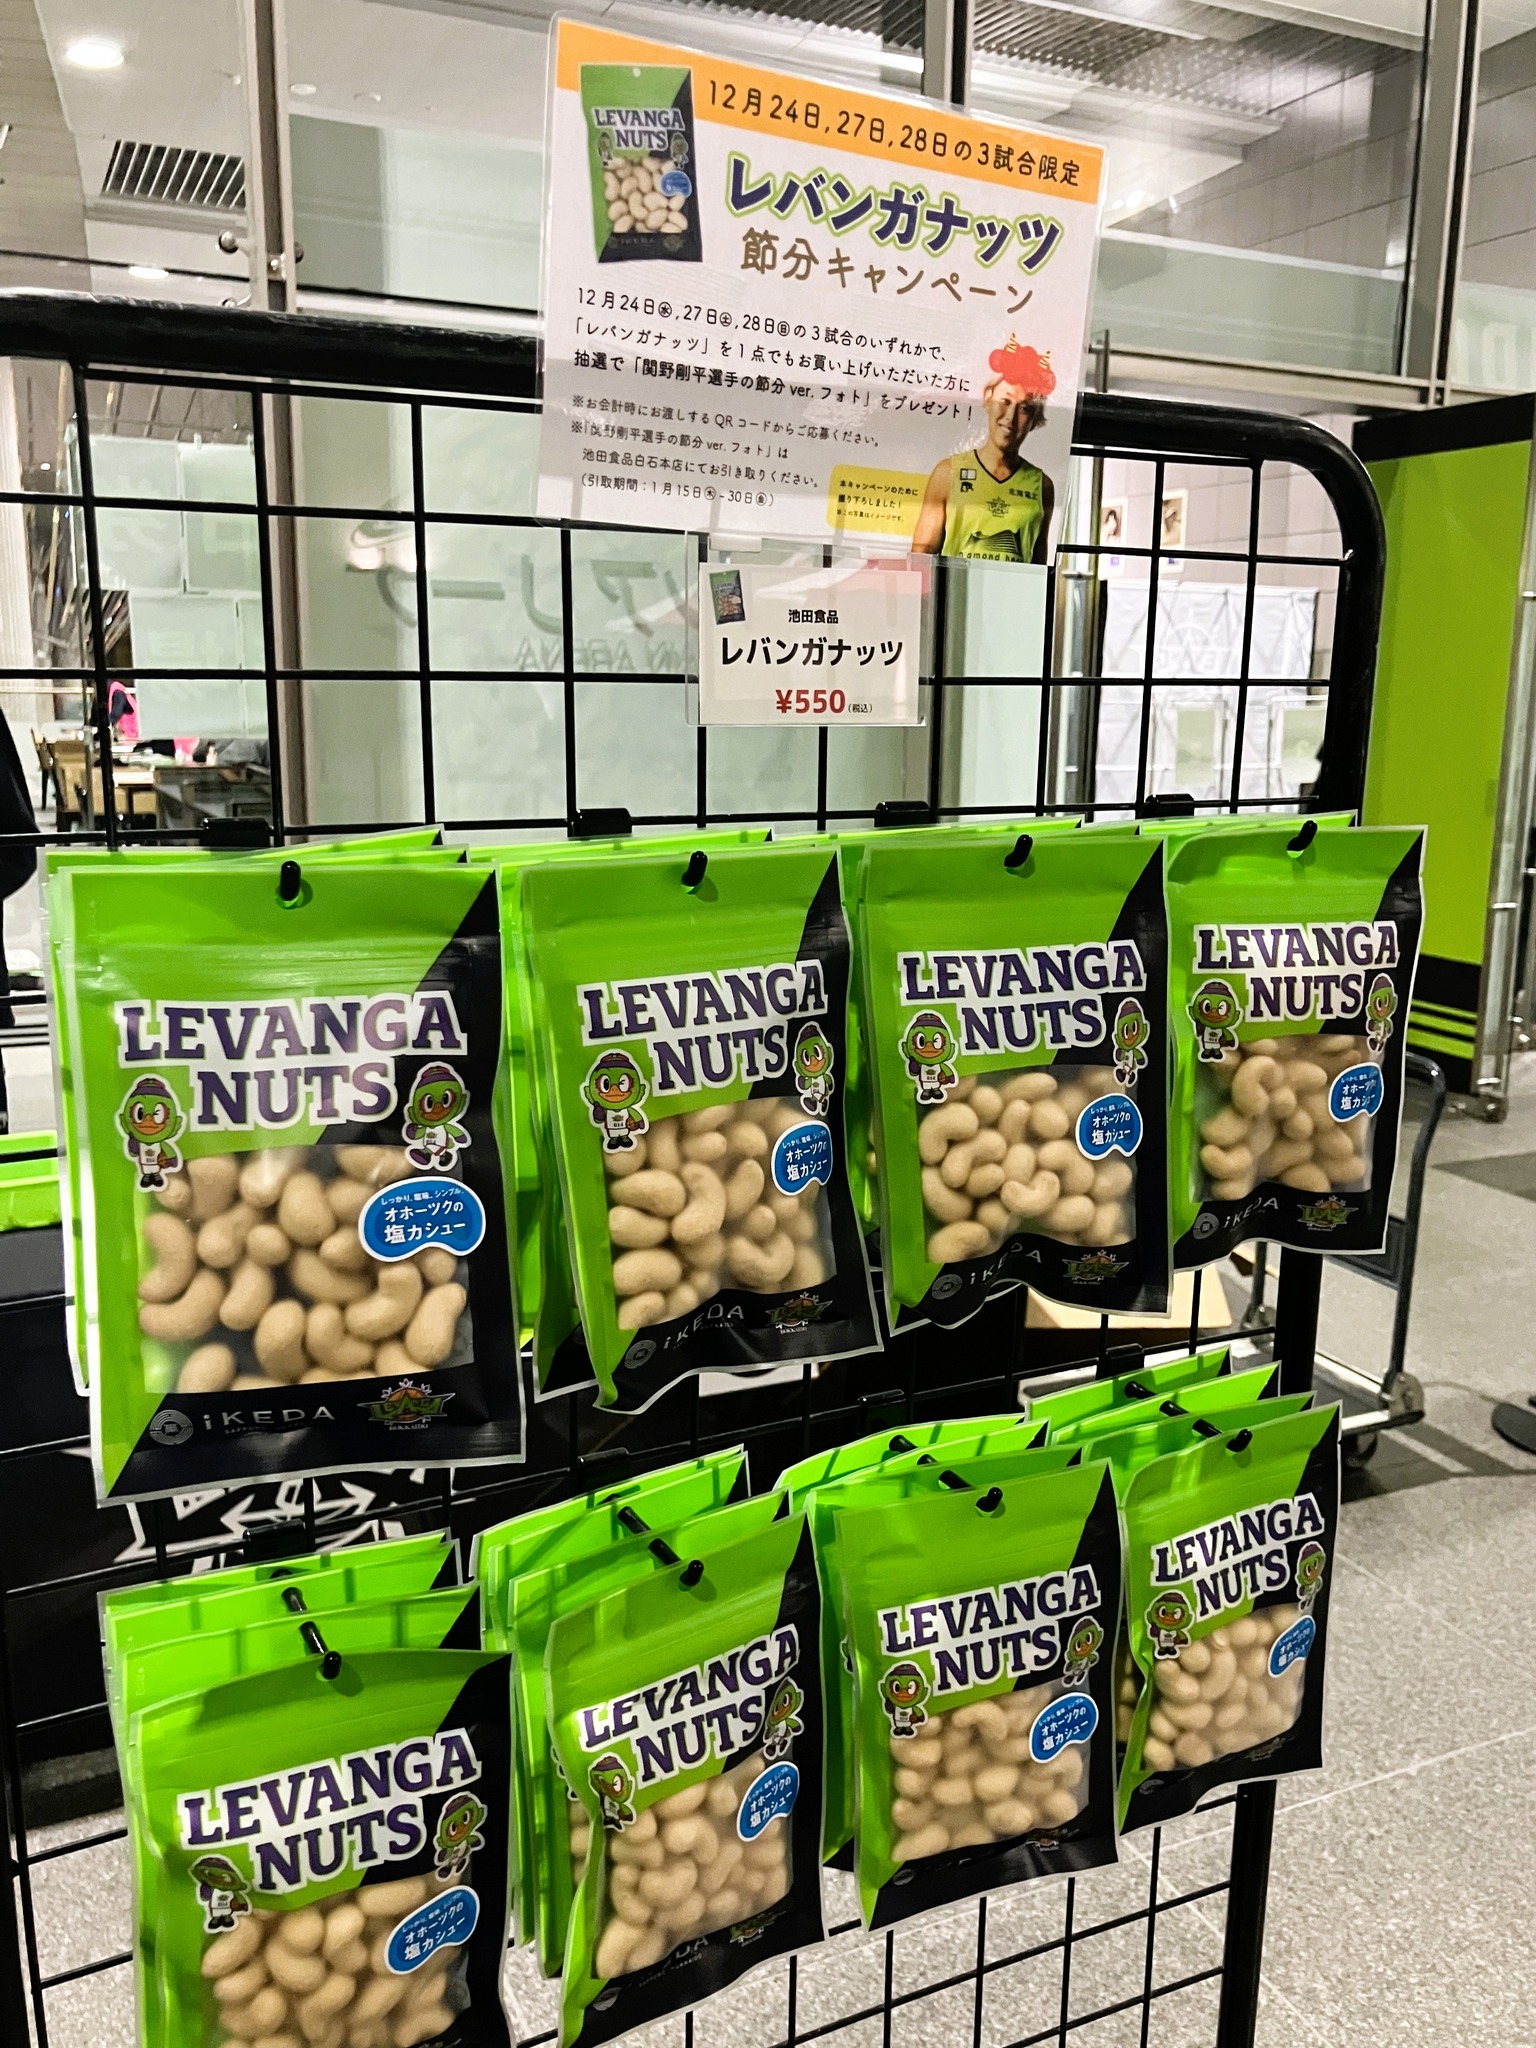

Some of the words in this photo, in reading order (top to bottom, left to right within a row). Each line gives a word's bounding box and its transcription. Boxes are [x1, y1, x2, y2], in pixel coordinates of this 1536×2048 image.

[594, 109, 683, 130] LEVANGA
[616, 130, 667, 149] NUTS
[730, 157, 1061, 270] レバンガナッツ
[740, 227, 1034, 314] 節分キャンペーン
[788, 609, 839, 624] 池田食品
[722, 637, 903, 666] レバンガナッツ
[776, 689, 846, 714] ¥550
[848, 703, 873, 714] (税込)
[902, 945, 1143, 1000] LEVANGA
[1197, 925, 1397, 969] LEVANGA
[583, 964, 825, 1040] LEVANGA
[1250, 971, 1362, 1017] NUTS
[122, 996, 462, 1062] LEVANGA
[961, 998, 1101, 1050] NUTS
[652, 1024, 787, 1090] NUTS
[196, 1062, 392, 1125] NUTS
[1092, 1128, 1131, 1145] 塩カシュー
[786, 1159, 828, 1181] 塩カシュー
[384, 1200, 463, 1223] オホーツクの
[384, 1222, 466, 1244] 塩カシュー
[1155, 1498, 1322, 1583] LEVANGA
[882, 1569, 1099, 1653] LEVANGA
[1196, 1548, 1287, 1618] NUTS
[935, 1625, 1057, 1690] NUTS
[584, 1630, 798, 1748] LEVANGA
[635, 1695, 764, 1783] NUTS
[184, 1735, 477, 1846] LEVANGA
[256, 1803, 422, 1890] NUTS
[404, 1917, 466, 1961] 塩カシュー
